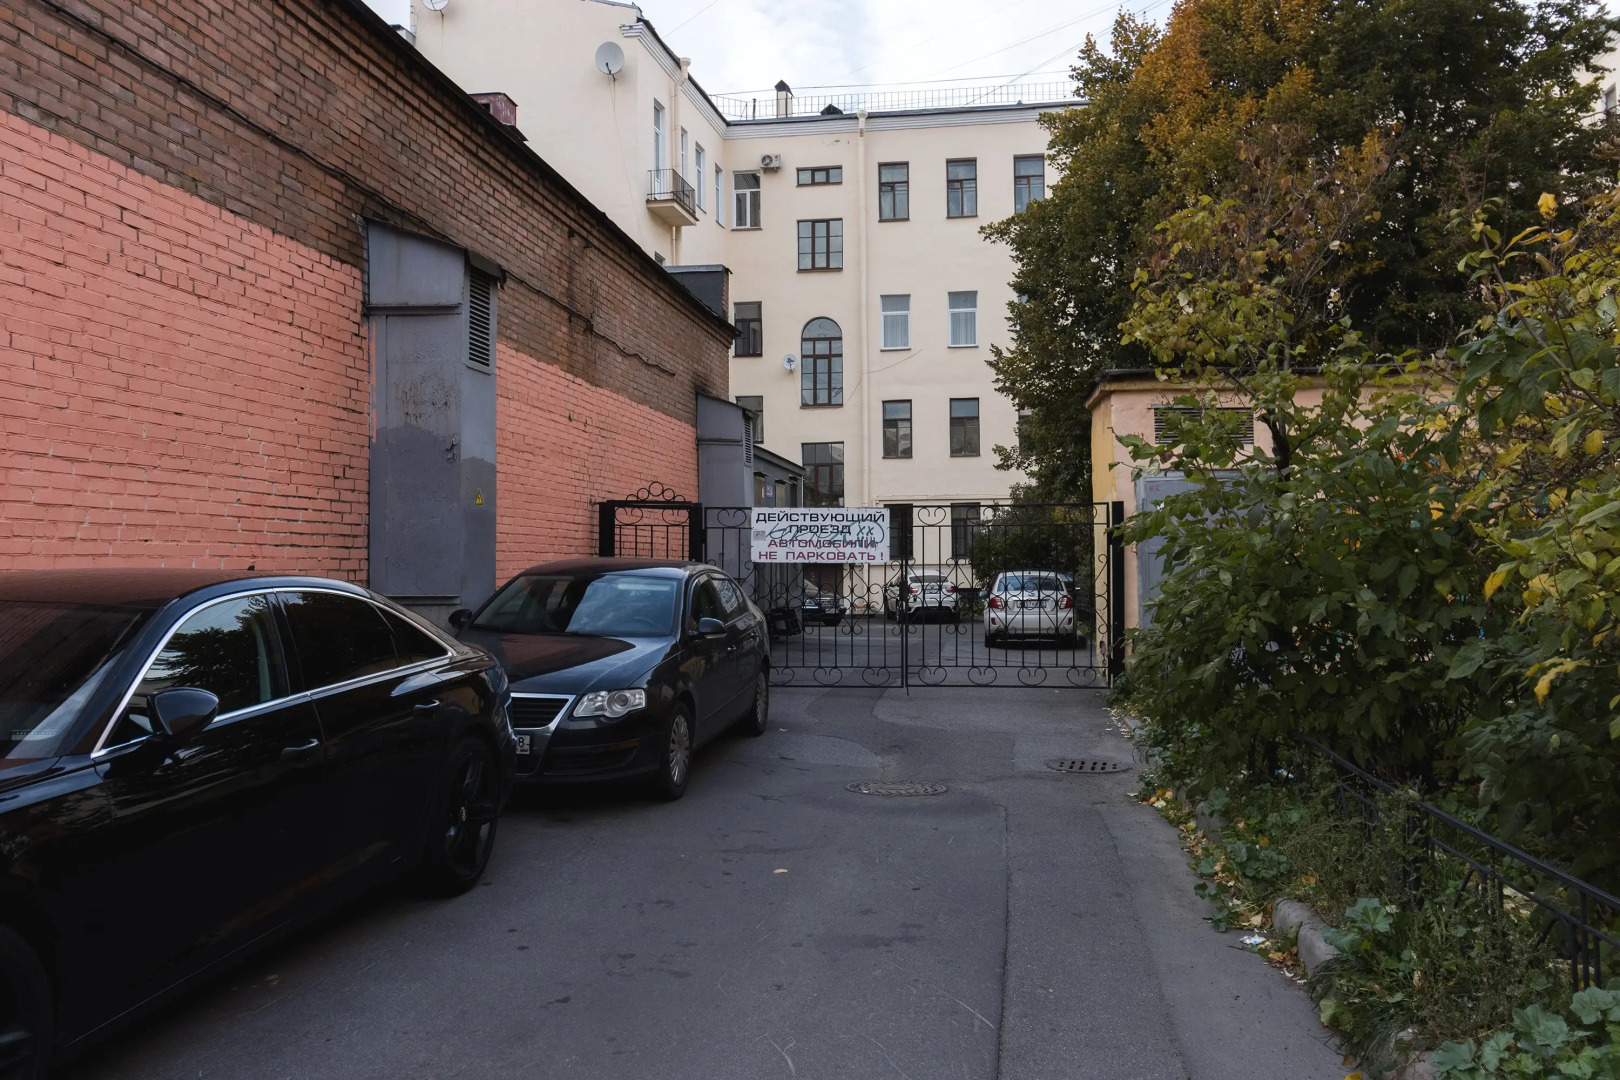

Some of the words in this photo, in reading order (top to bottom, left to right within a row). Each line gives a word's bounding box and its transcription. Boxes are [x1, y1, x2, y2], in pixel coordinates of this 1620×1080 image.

[755, 511, 885, 523] ДЕЙСТВУЮЩИЙ
[789, 524, 852, 535] ПРОЕЗД
[767, 539, 877, 548] АВТОМОБИЛИ
[758, 551, 778, 560] НЕ
